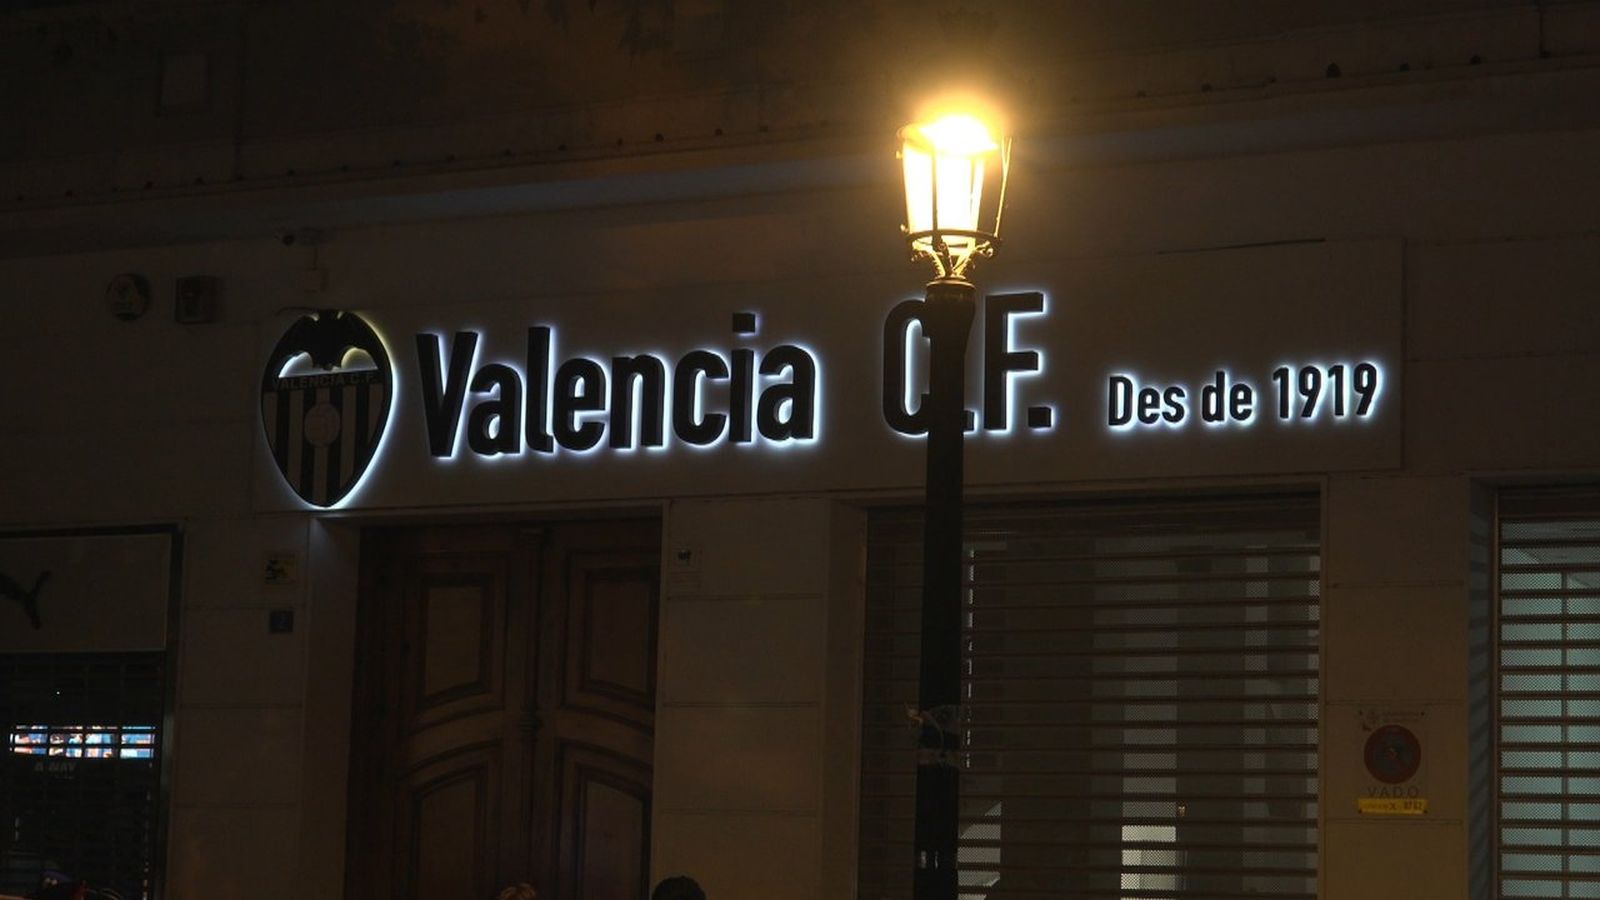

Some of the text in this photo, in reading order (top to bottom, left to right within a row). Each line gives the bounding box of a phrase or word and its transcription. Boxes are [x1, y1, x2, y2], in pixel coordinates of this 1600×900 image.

[416, 312, 816, 458] Valencia
[1108, 362, 1378, 426] Des de 1919
[1366, 785, 1420, 799] VADO
